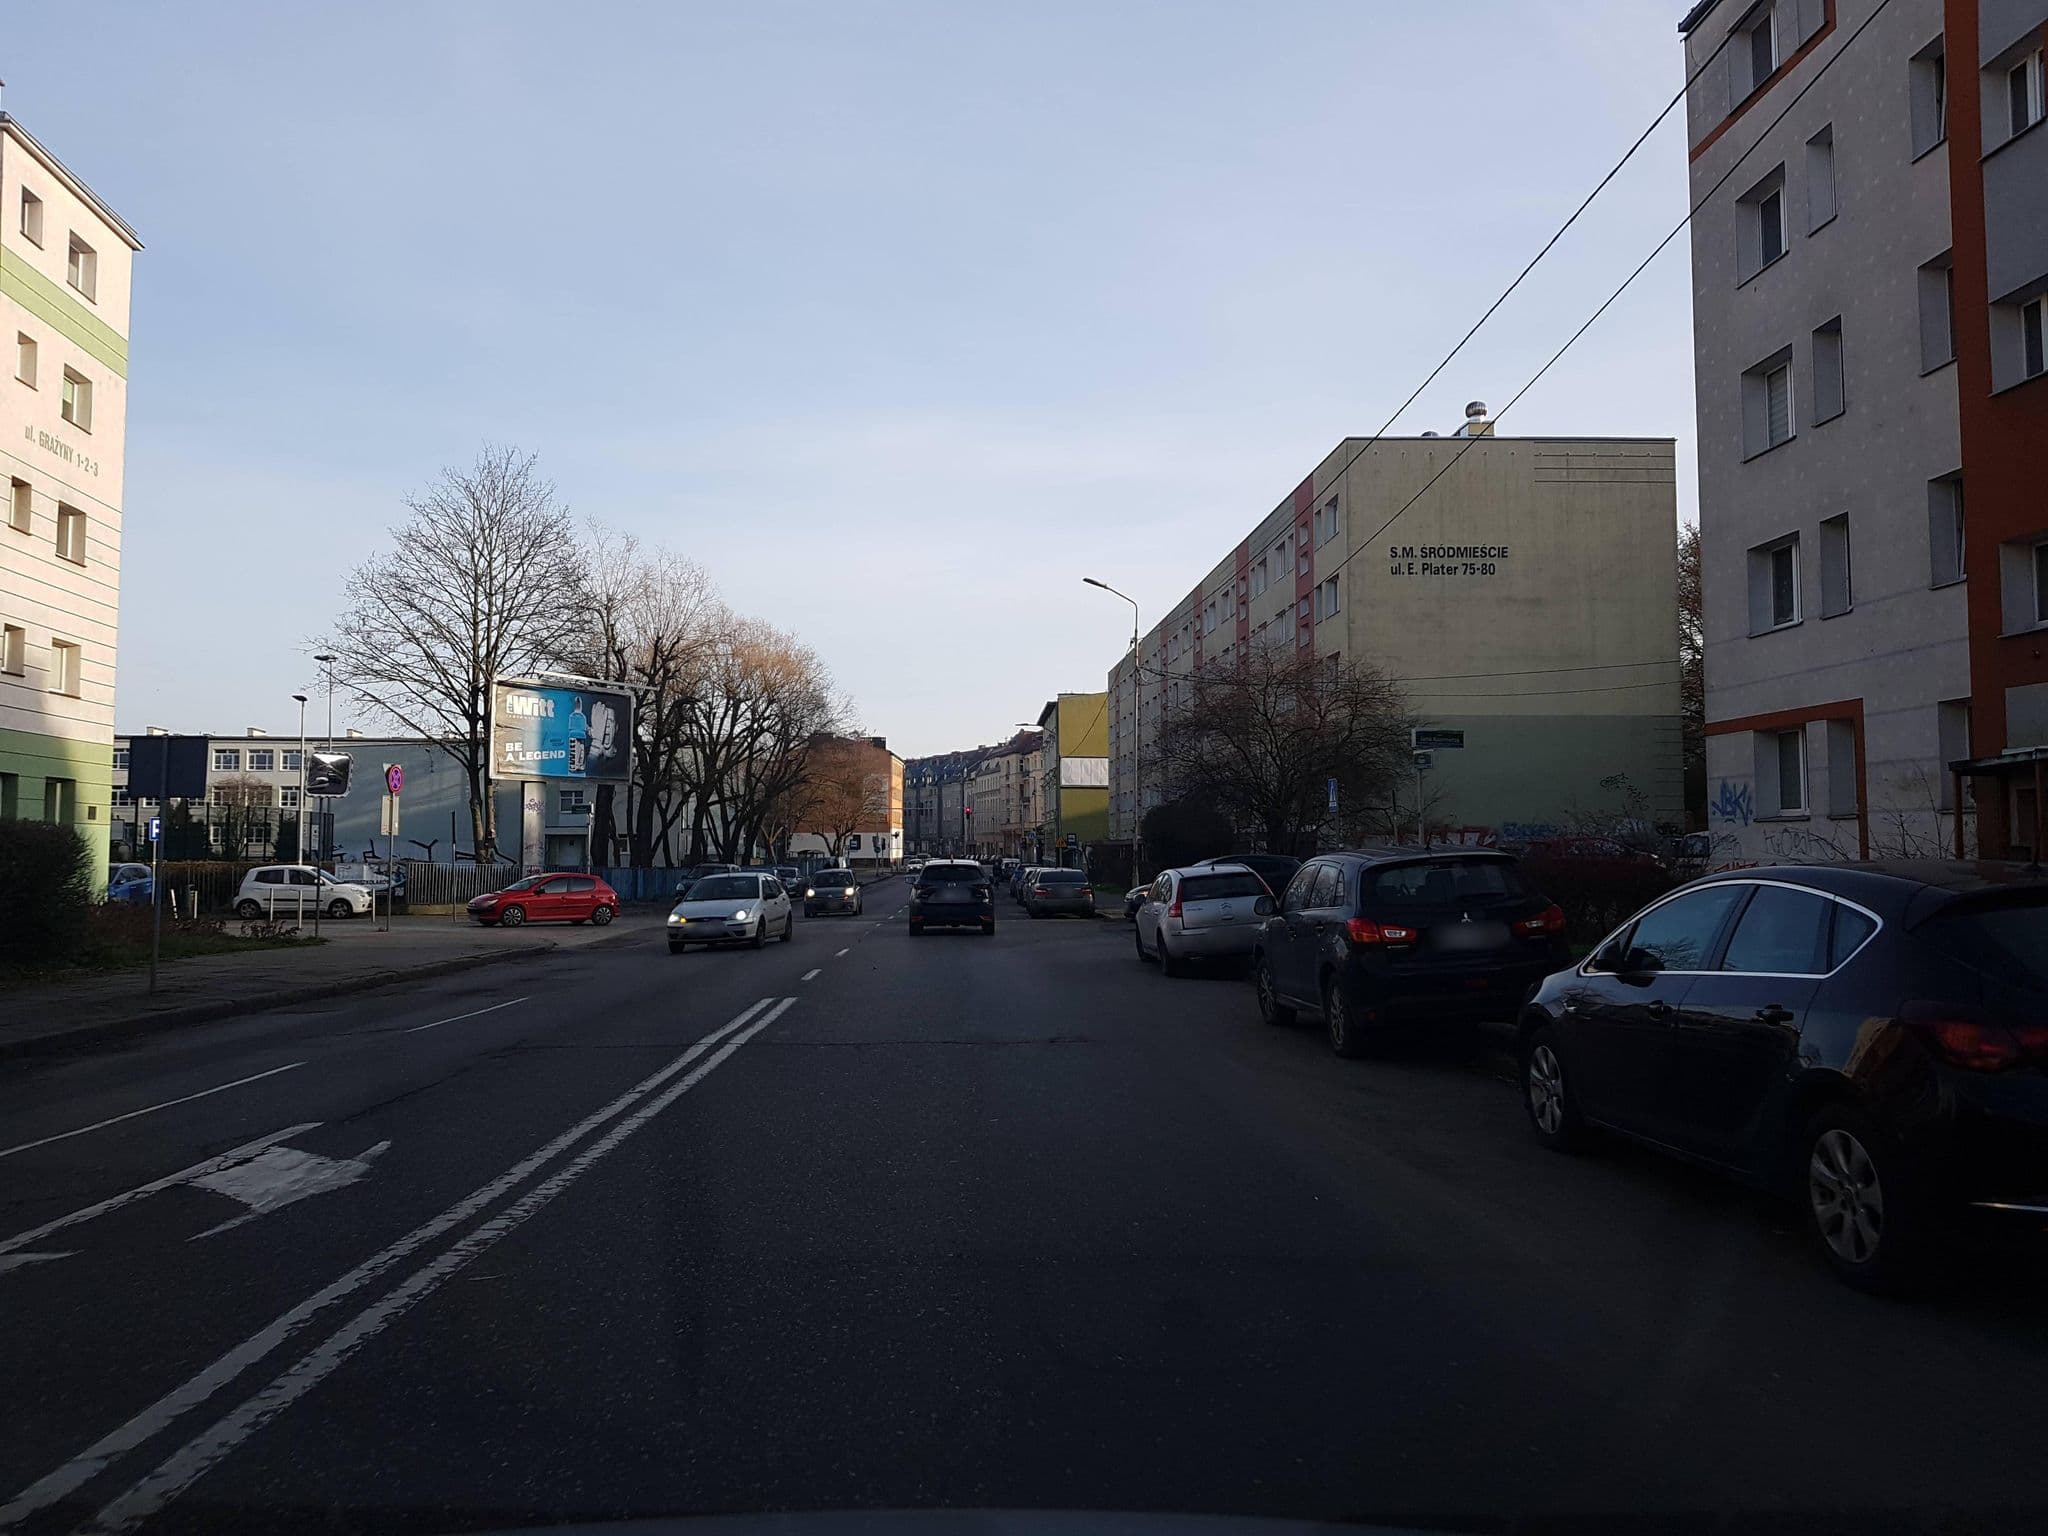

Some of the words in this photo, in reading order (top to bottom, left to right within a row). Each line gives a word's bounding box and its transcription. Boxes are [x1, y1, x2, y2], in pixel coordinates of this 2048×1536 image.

[25, 425, 36, 443] ul.
[1390, 546, 1417, 559] S.M.
[1420, 544, 1509, 559] ŚRÓDMIEŚCIE
[1391, 563, 1405, 576] ul.
[1408, 563, 1418, 576] E.
[1422, 563, 1459, 576] Plater
[1462, 563, 1496, 576] 75-80
[505, 742, 523, 752] BE
[506, 753, 515, 762] A
[518, 750, 566, 761] LEGEND
